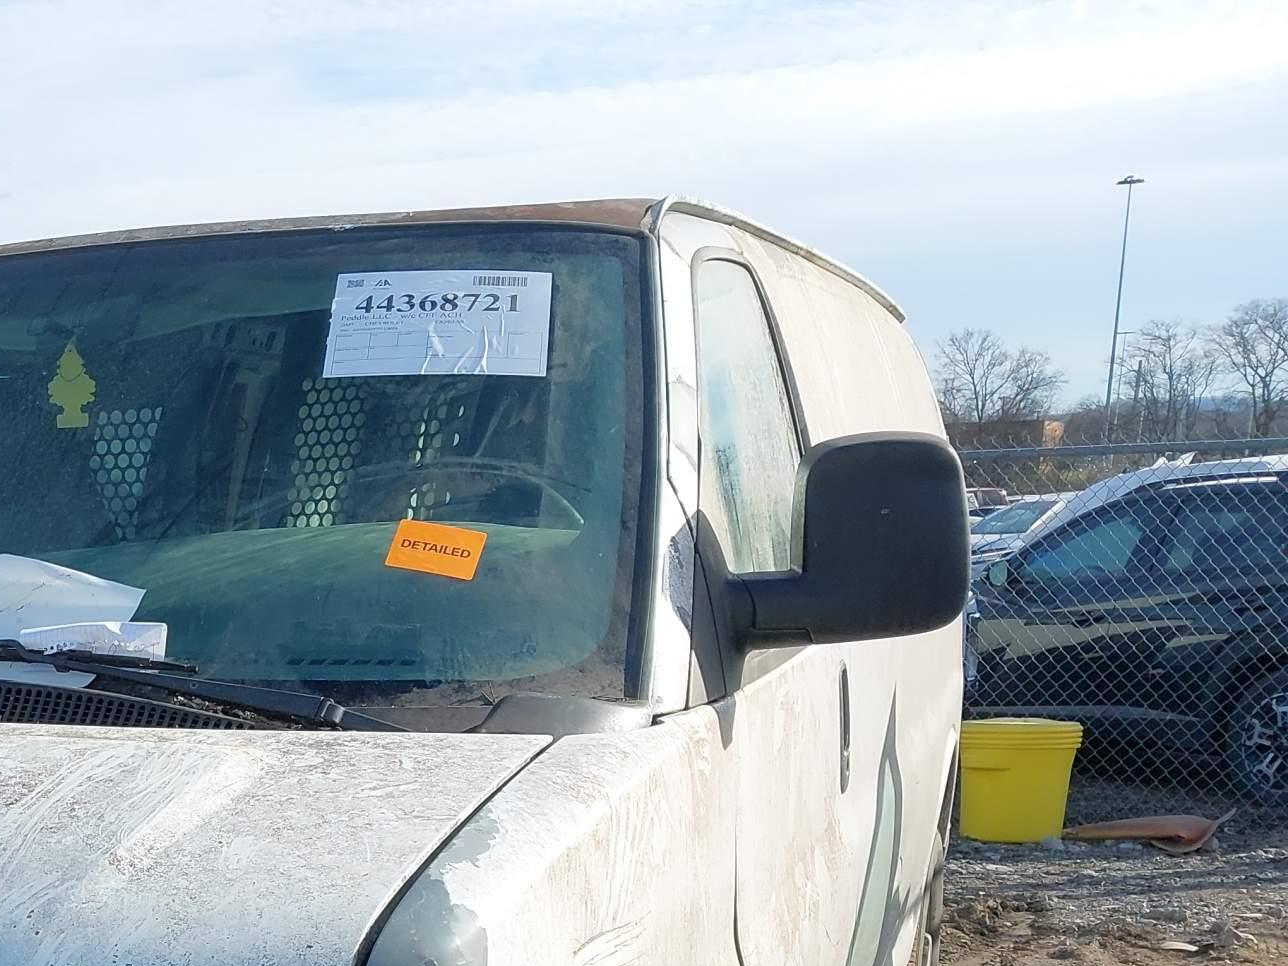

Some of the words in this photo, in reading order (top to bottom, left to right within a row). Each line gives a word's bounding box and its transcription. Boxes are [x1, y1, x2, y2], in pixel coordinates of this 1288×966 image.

[355, 293, 521, 314] 44368721
[341, 313, 370, 321] Peddle
[400, 539, 471, 558] DETAILED
